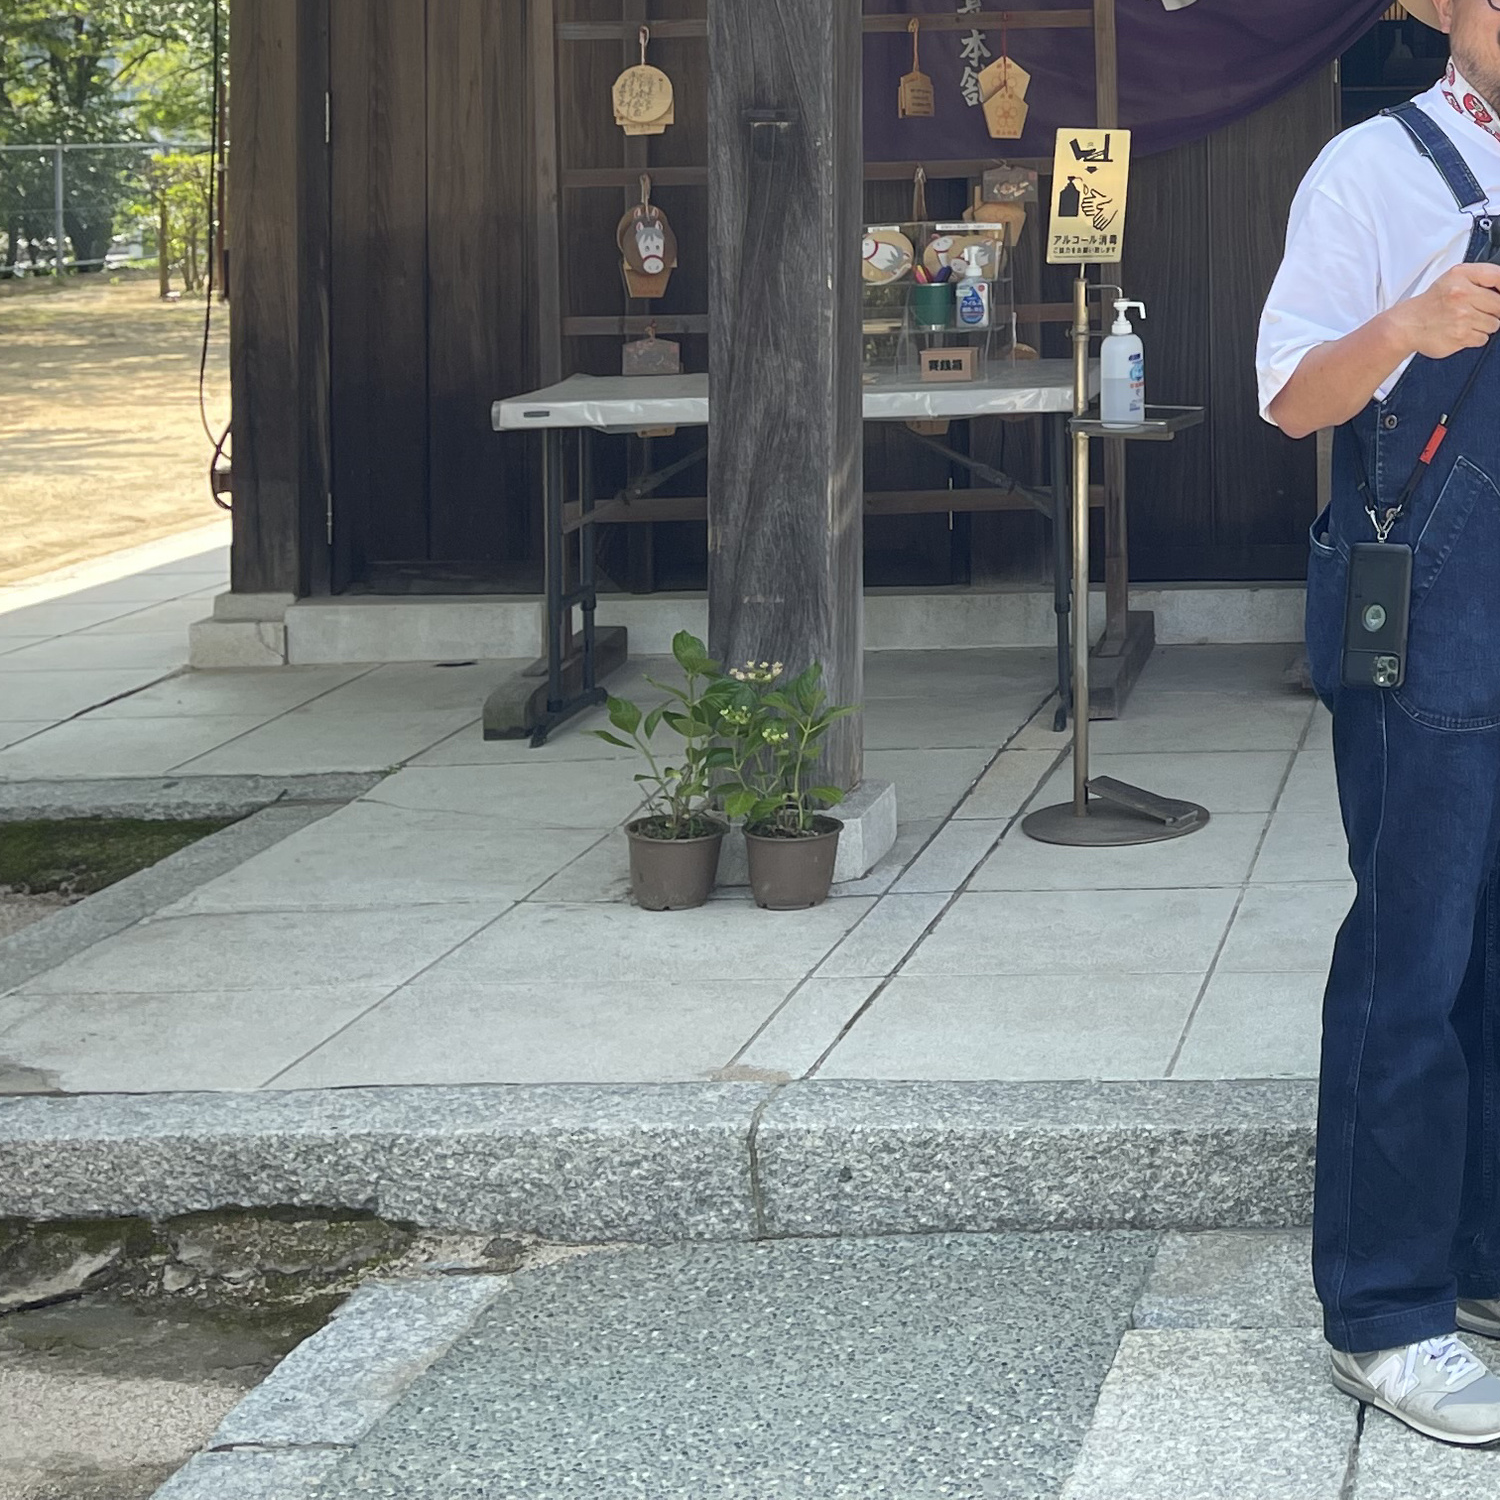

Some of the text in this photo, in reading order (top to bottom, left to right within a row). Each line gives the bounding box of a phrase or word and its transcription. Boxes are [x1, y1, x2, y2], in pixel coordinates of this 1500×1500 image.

[1053, 234, 1118, 246] アルコール消毒
